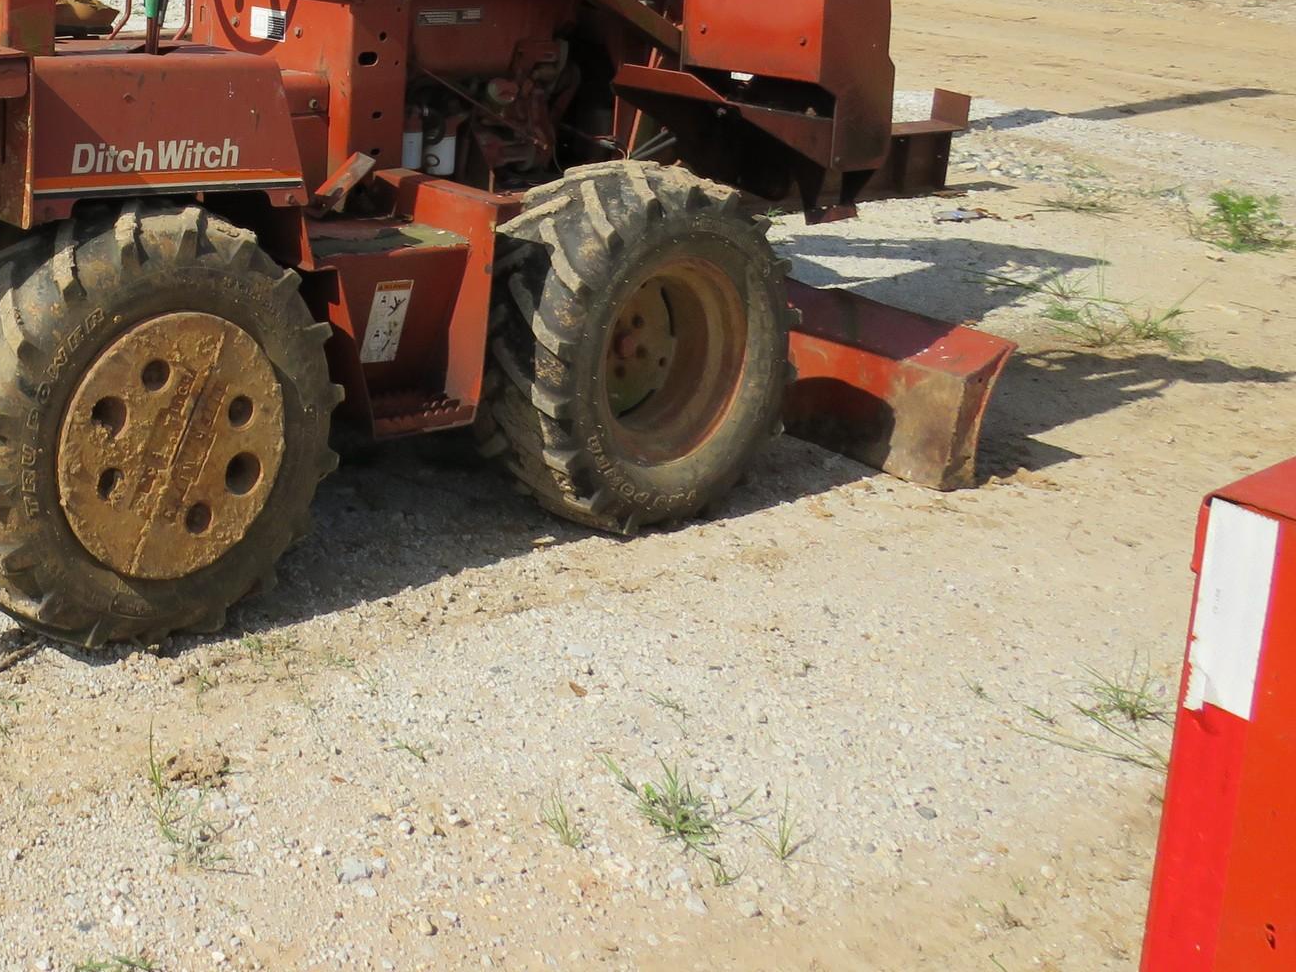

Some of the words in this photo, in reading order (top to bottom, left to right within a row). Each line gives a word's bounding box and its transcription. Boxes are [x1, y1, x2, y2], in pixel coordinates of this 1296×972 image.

[71, 141, 154, 175] Ditch
[157, 137, 240, 171] Witch
[25, 307, 105, 430] POWER
